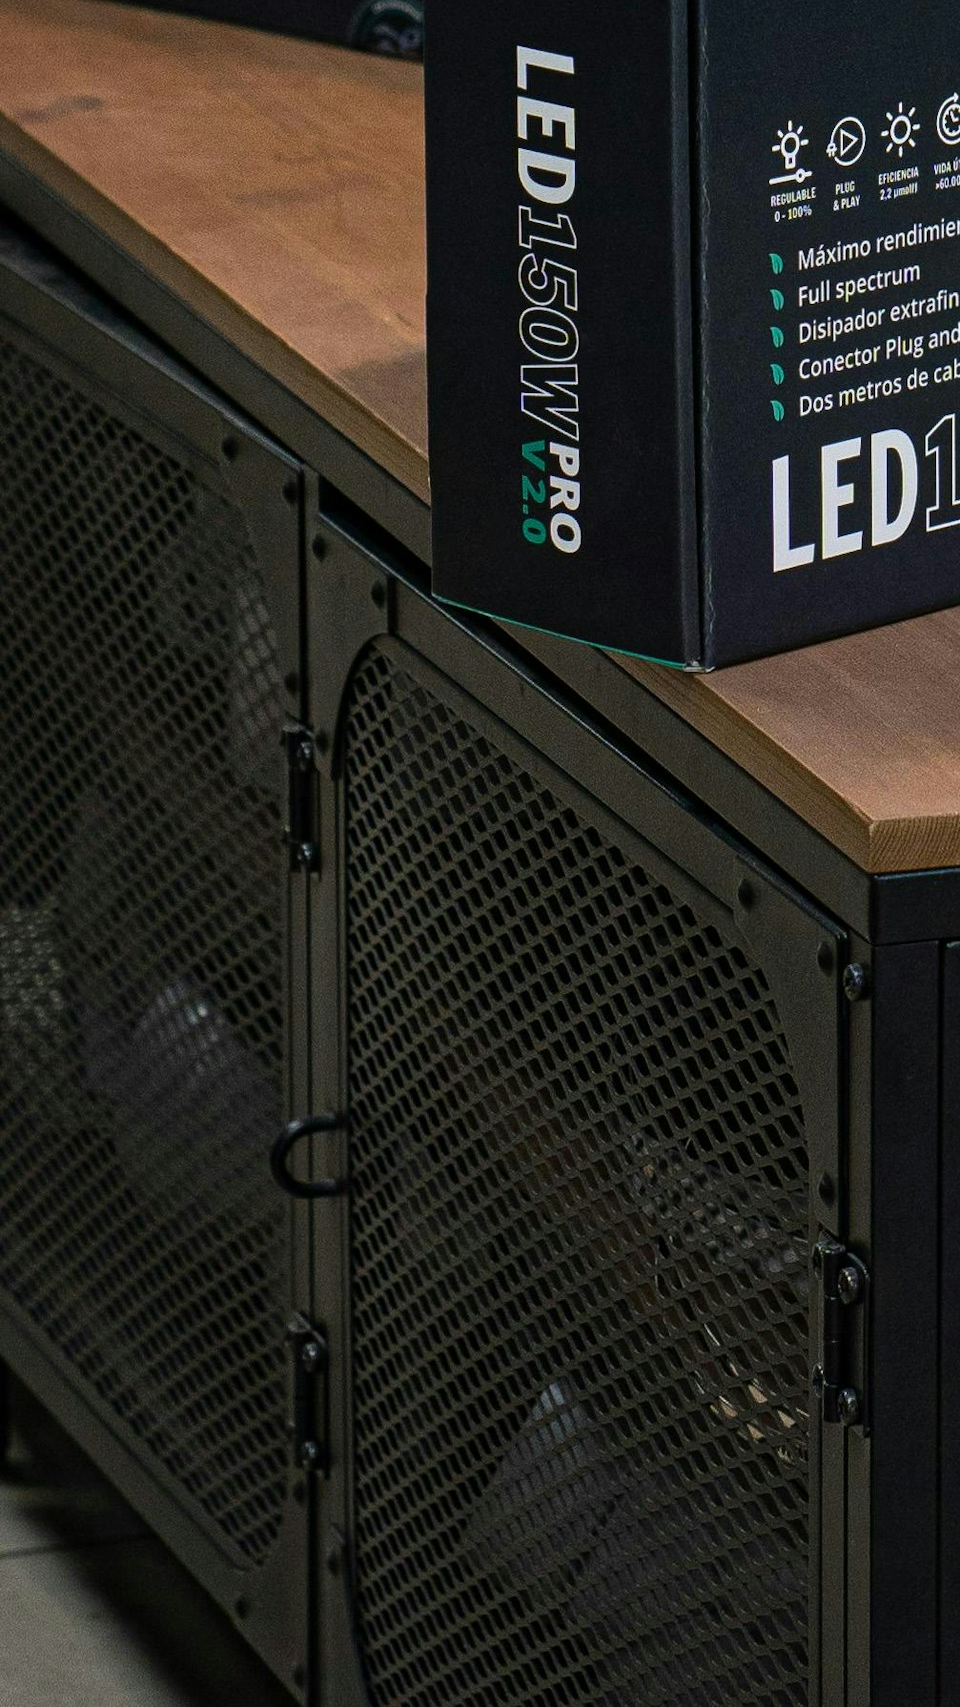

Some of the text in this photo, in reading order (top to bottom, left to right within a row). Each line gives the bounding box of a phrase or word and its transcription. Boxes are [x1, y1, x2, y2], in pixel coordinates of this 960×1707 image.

[878, 166, 919, 186] EFICIENCIA
[933, 160, 952, 175] VIDA
[770, 186, 817, 208] REGULABLE
[835, 181, 855, 195] PLUG
[787, 205, 812, 220] 100%
[841, 195, 861, 210] PLAY
[798, 239, 871, 270] Máximo
[798, 264, 921, 307] Full spectrum
[799, 308, 885, 344] Disipador
[799, 345, 880, 380] Conector
[886, 335, 924, 360] Plug
[928, 322, 960, 350] and
[800, 394, 833, 417] Dos
[839, 375, 901, 407] metros
[907, 367, 929, 390] de
